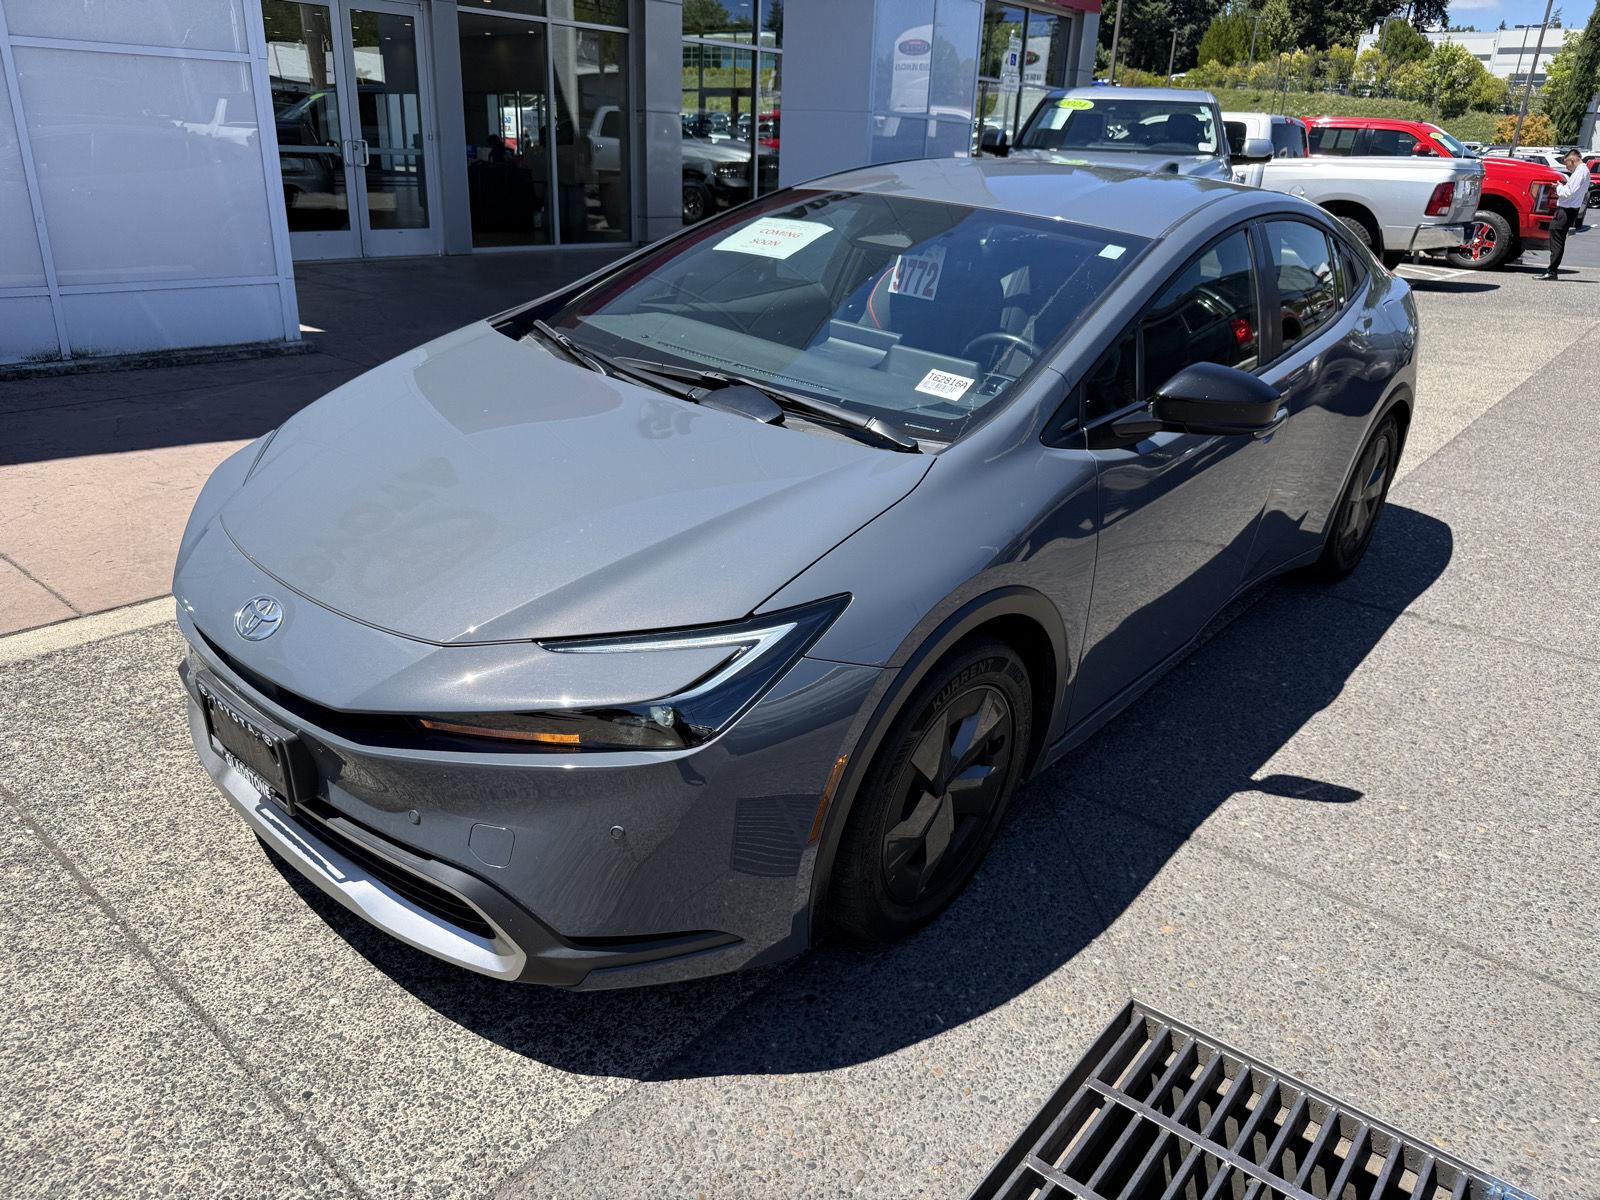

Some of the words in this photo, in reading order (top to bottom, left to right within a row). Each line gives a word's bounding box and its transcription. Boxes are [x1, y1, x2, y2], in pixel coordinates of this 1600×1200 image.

[750, 238, 782, 248] SOON
[760, 228, 801, 238] COMING
[892, 257, 940, 298] 9772
[928, 372, 968, 390] T62816A
[932, 658, 995, 712] KURRENT
[210, 694, 255, 736] TOYOTA
[224, 753, 273, 800] GLADSTONE
